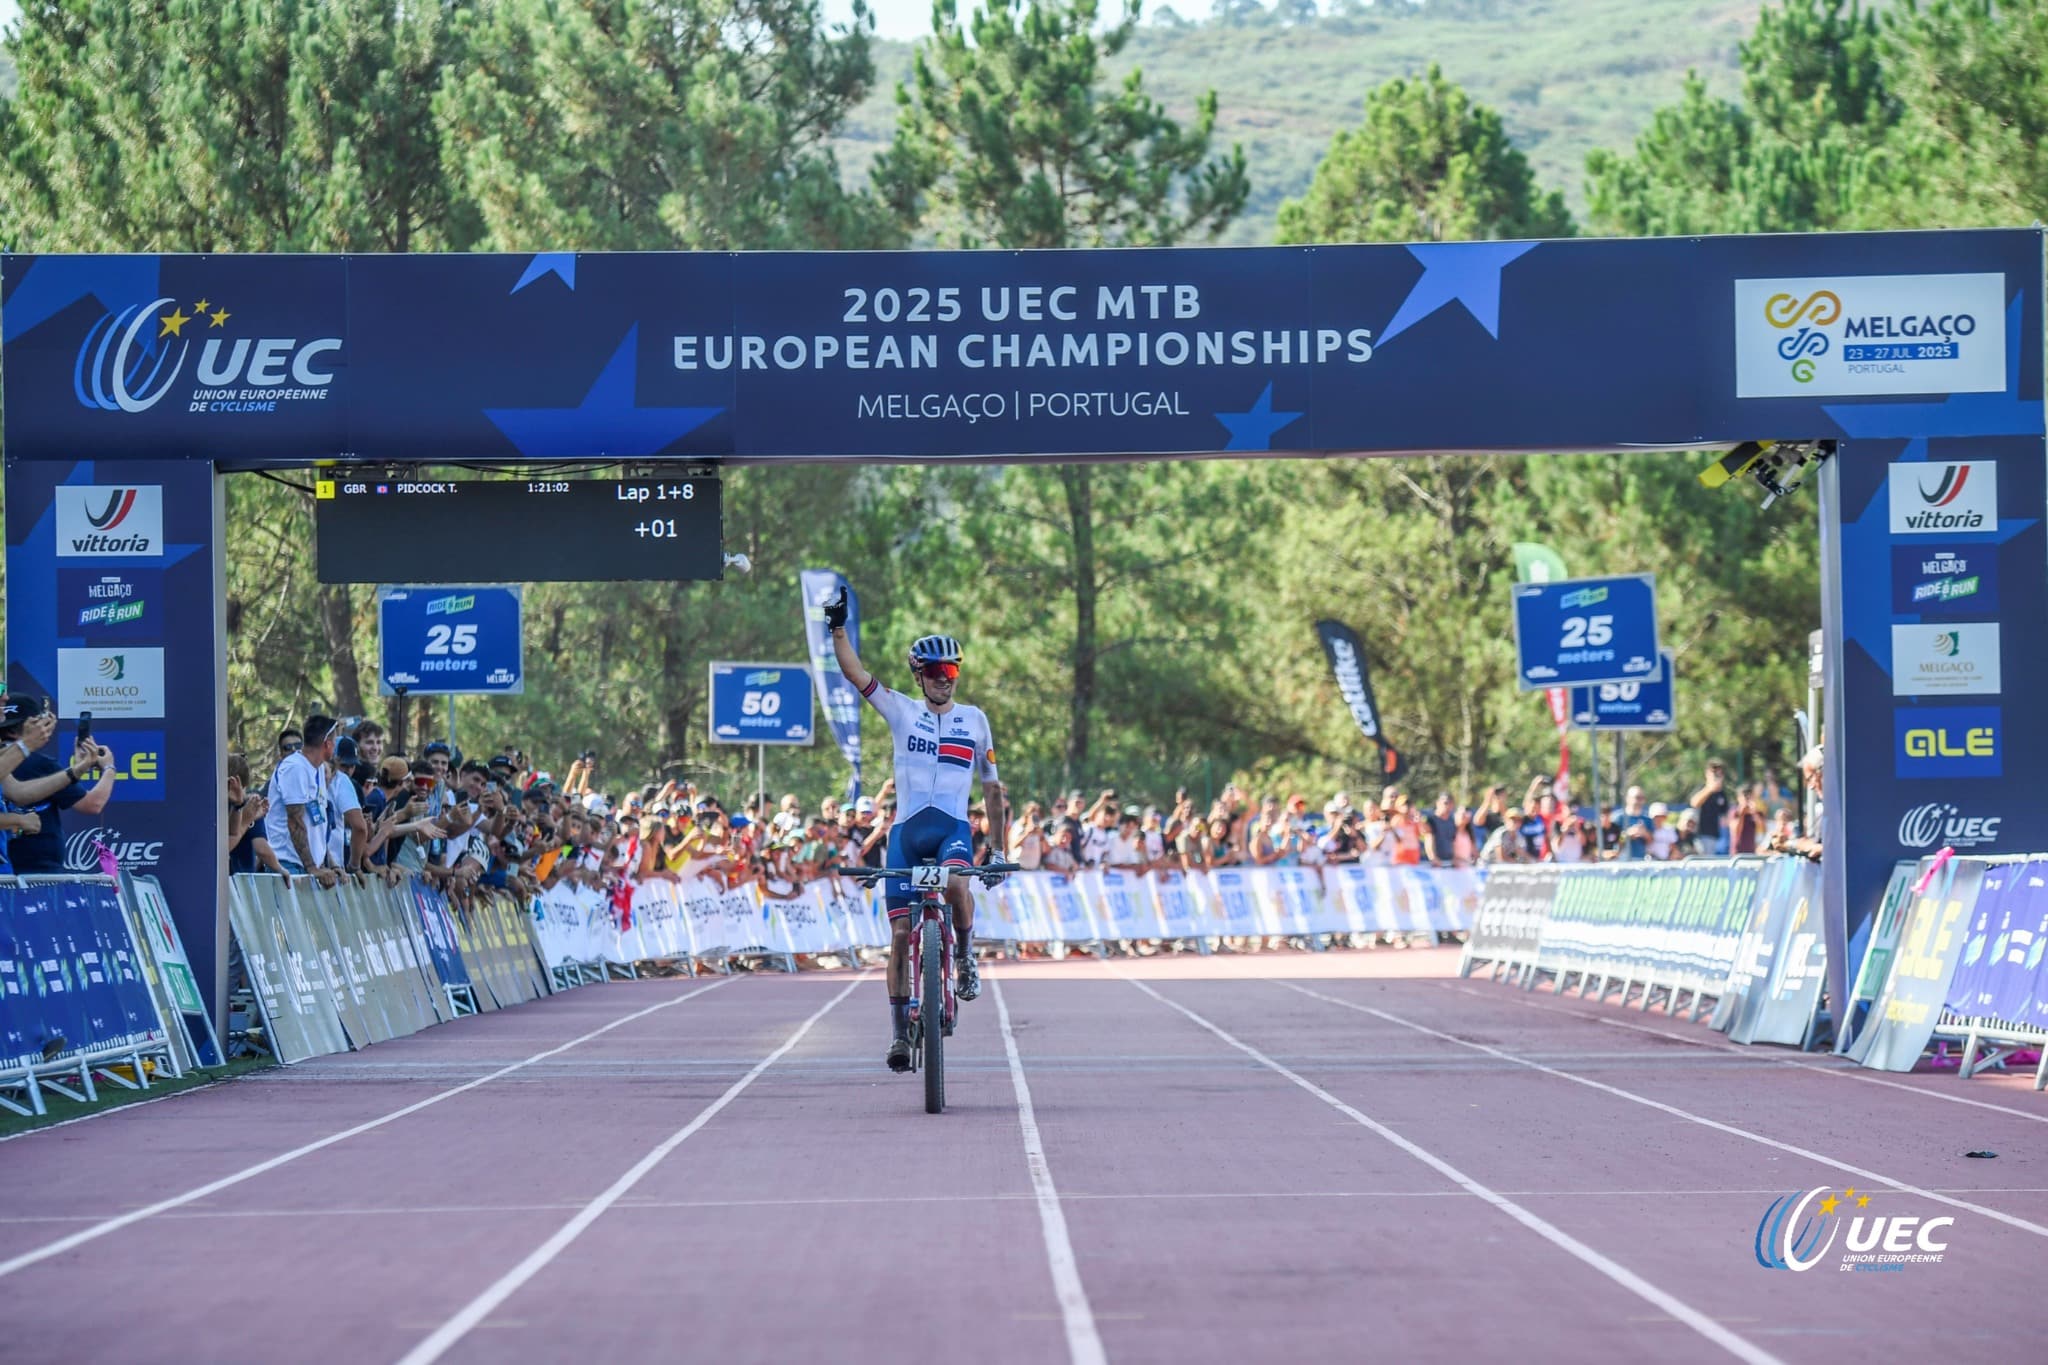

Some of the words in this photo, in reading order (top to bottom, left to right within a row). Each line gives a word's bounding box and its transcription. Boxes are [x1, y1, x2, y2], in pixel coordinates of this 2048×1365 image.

[843, 287, 961, 322] 2025
[981, 286, 1077, 321] UEC
[1096, 285, 1200, 320] MTB
[1844, 314, 1976, 343] MELGAÇO
[674, 335, 938, 370] EUROPEAN
[958, 329, 1373, 368] CHAMPIONSHIPS
[1848, 348, 1864, 360] 23
[1874, 347, 1890, 360] 27
[1891, 347, 1913, 359] JUL
[1917, 346, 1952, 358] 2025
[196, 338, 343, 386] UEC
[1847, 363, 1906, 374] PORTUGAL
[192, 390, 237, 400] UNION
[239, 388, 329, 400] EUROPÉENNE
[189, 402, 208, 413] DE
[209, 401, 277, 413] CYCLISME
[857, 393, 1006, 424] MELGAÇO
[1029, 391, 1190, 417] PORTUGAL
[344, 484, 367, 494] GBR
[397, 483, 446, 494] PIDCOCK
[448, 483, 458, 494] T.
[527, 483, 570, 493] 1:21:02
[617, 484, 650, 503] Lap
[657, 484, 694, 500] 1+8
[634, 519, 678, 538] +01
[1905, 509, 1984, 529] vittoria
[72, 534, 150, 552] vittoria
[1915, 581, 1942, 599] RIDE
[1951, 580, 1976, 597] RUN
[81, 605, 108, 623] RIDE
[116, 603, 141, 620] RUN
[424, 624, 478, 655] 25
[1560, 615, 1613, 648] 25
[420, 658, 478, 672] meters
[1557, 649, 1615, 665] meters
[1600, 681, 1641, 702] 50
[741, 691, 781, 716] 50
[739, 716, 782, 728] meters
[907, 735, 938, 756] GBR
[1945, 817, 2002, 837] UEC
[110, 842, 164, 861] UEC
[919, 866, 941, 886] 23
